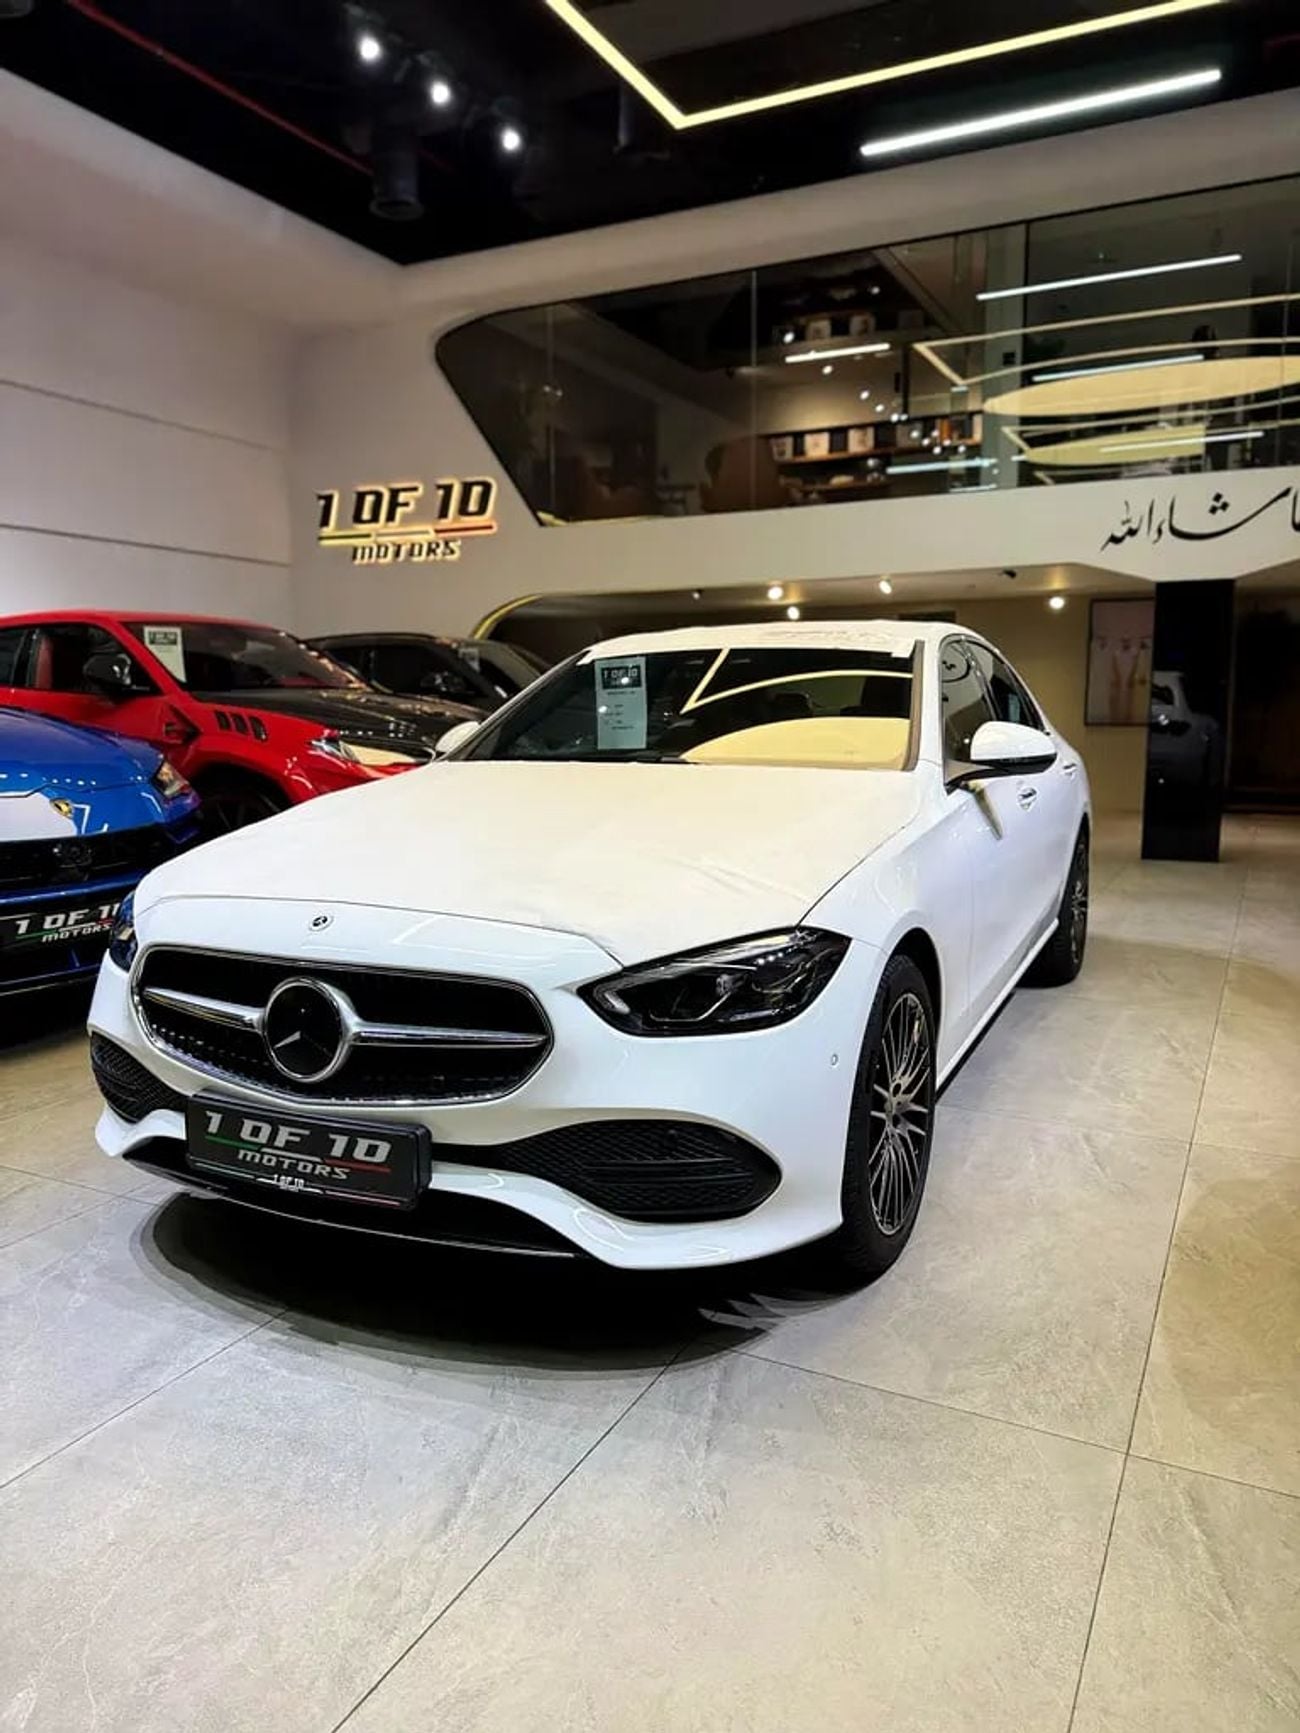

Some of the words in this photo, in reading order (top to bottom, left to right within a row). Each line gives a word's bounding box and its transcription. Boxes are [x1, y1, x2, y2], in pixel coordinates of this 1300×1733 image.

[316, 492, 335, 529] 1
[352, 485, 420, 525] OF
[435, 479, 493, 521] 10
[351, 540, 460, 563] MOTORS
[15, 919, 30, 934] 1
[42, 908, 91, 930] OF
[41, 923, 111, 943] MOTORS
[205, 1109, 224, 1134] 1
[239, 1117, 311, 1149] OF
[328, 1132, 393, 1164] 10
[237, 1148, 351, 1180] MOTORS
